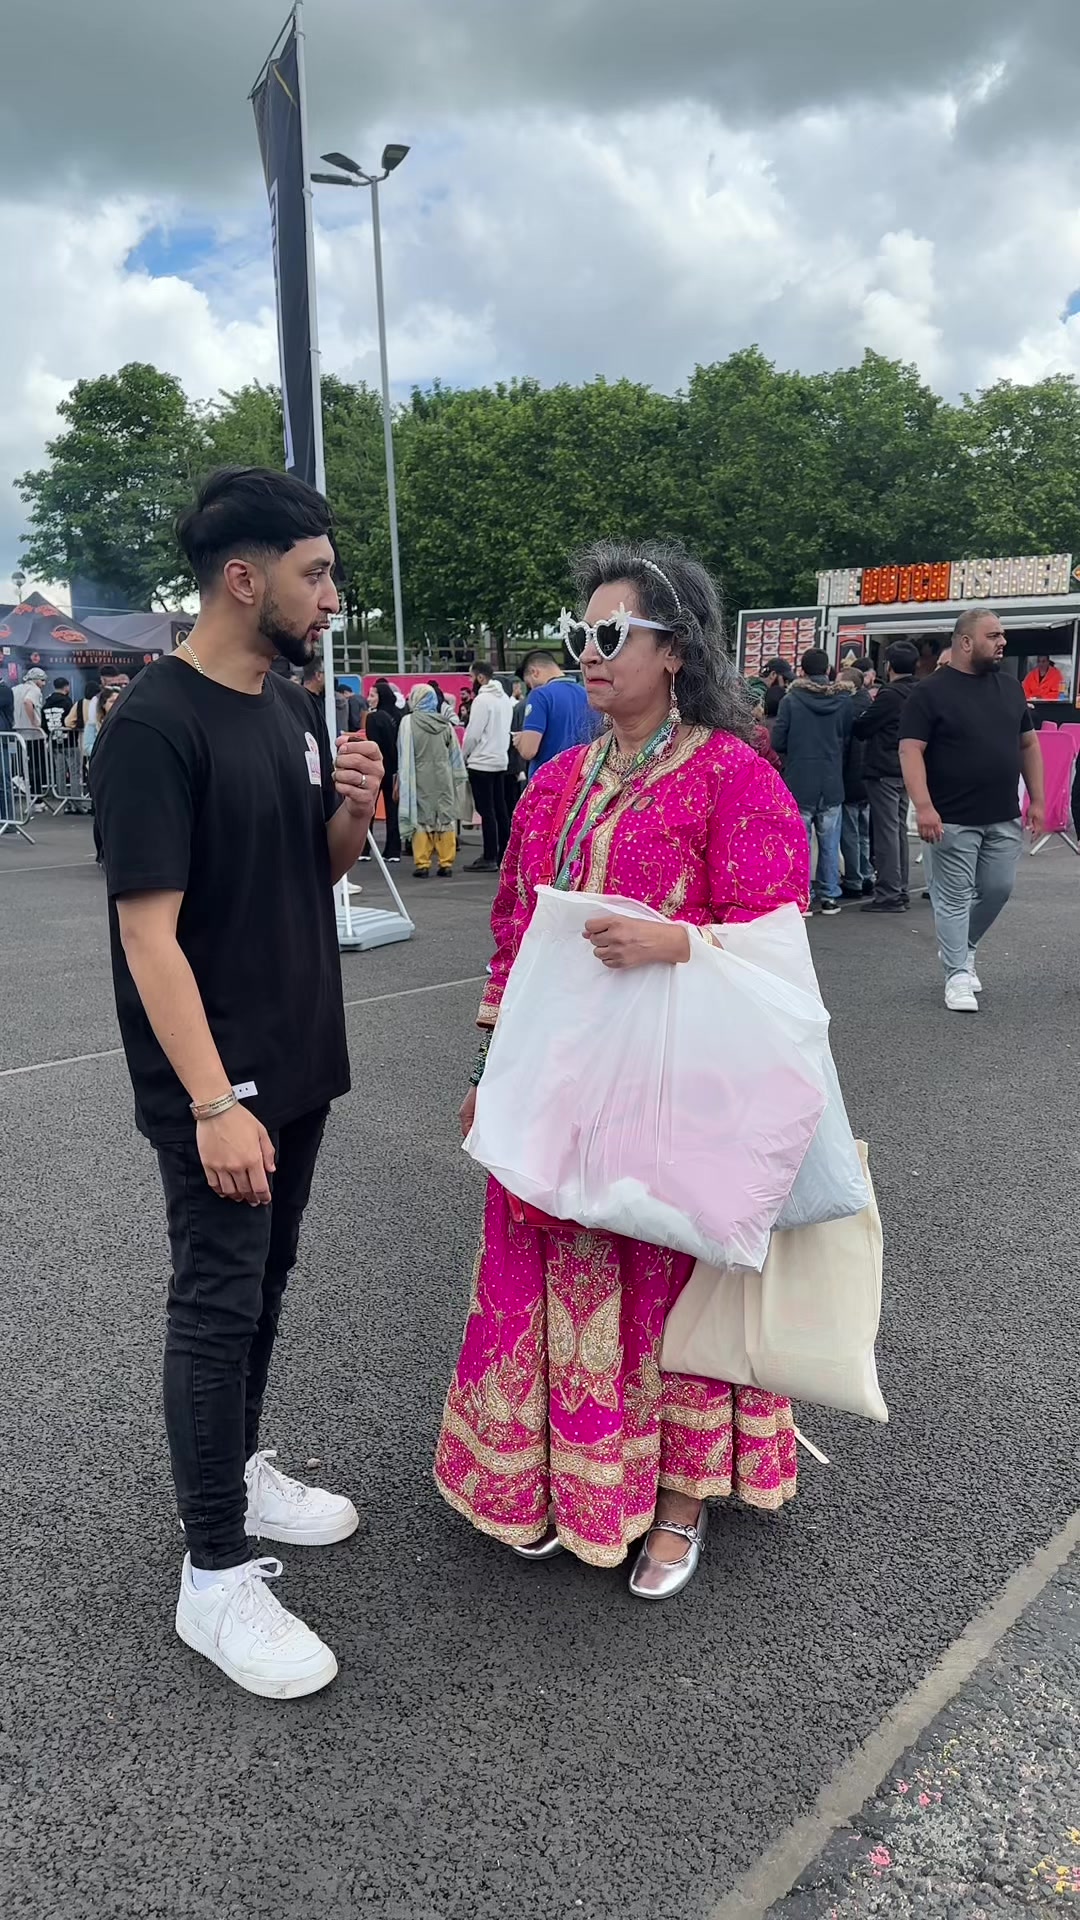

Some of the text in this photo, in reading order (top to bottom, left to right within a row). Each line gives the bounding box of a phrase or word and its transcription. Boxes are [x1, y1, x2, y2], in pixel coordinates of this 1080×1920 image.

[816, 553, 1073, 606] THE DUTCH FISHMEN
